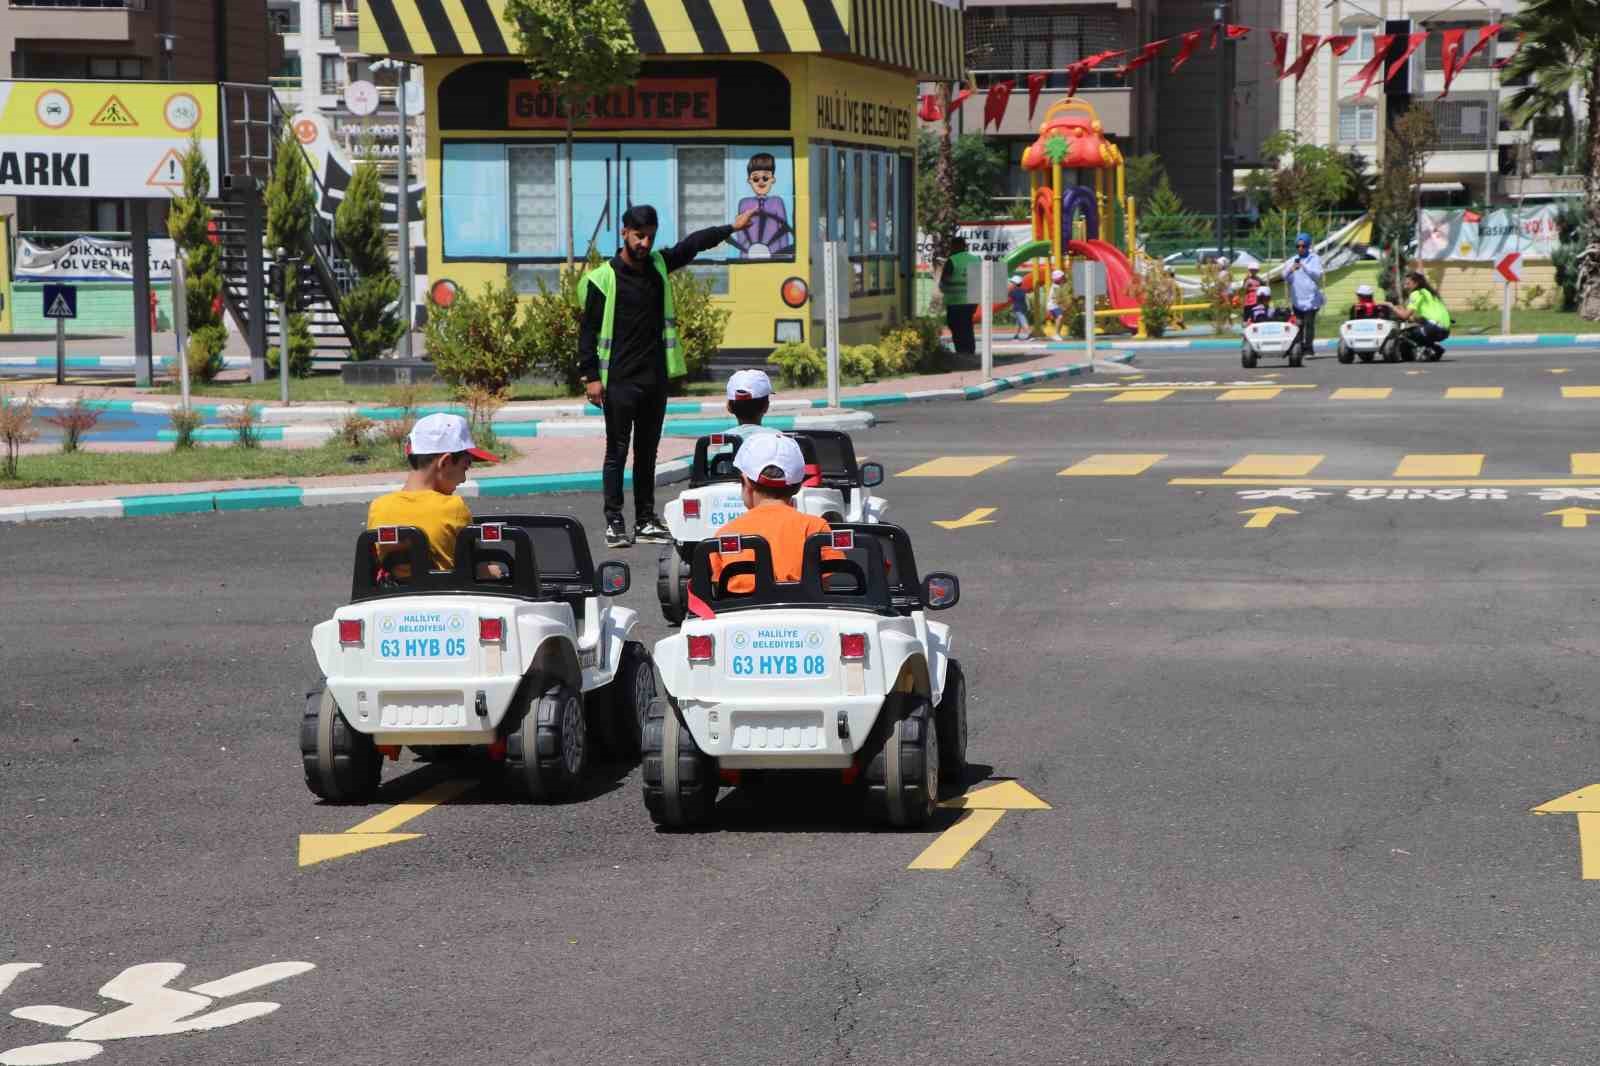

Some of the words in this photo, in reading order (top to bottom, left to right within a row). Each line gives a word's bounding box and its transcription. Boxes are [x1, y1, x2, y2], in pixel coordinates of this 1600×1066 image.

[381, 639, 400, 657] 63
[405, 639, 440, 657] HYB
[446, 638, 465, 656] 05
[733, 655, 753, 674] 63
[759, 655, 797, 674] HYB
[803, 655, 825, 674] 08
